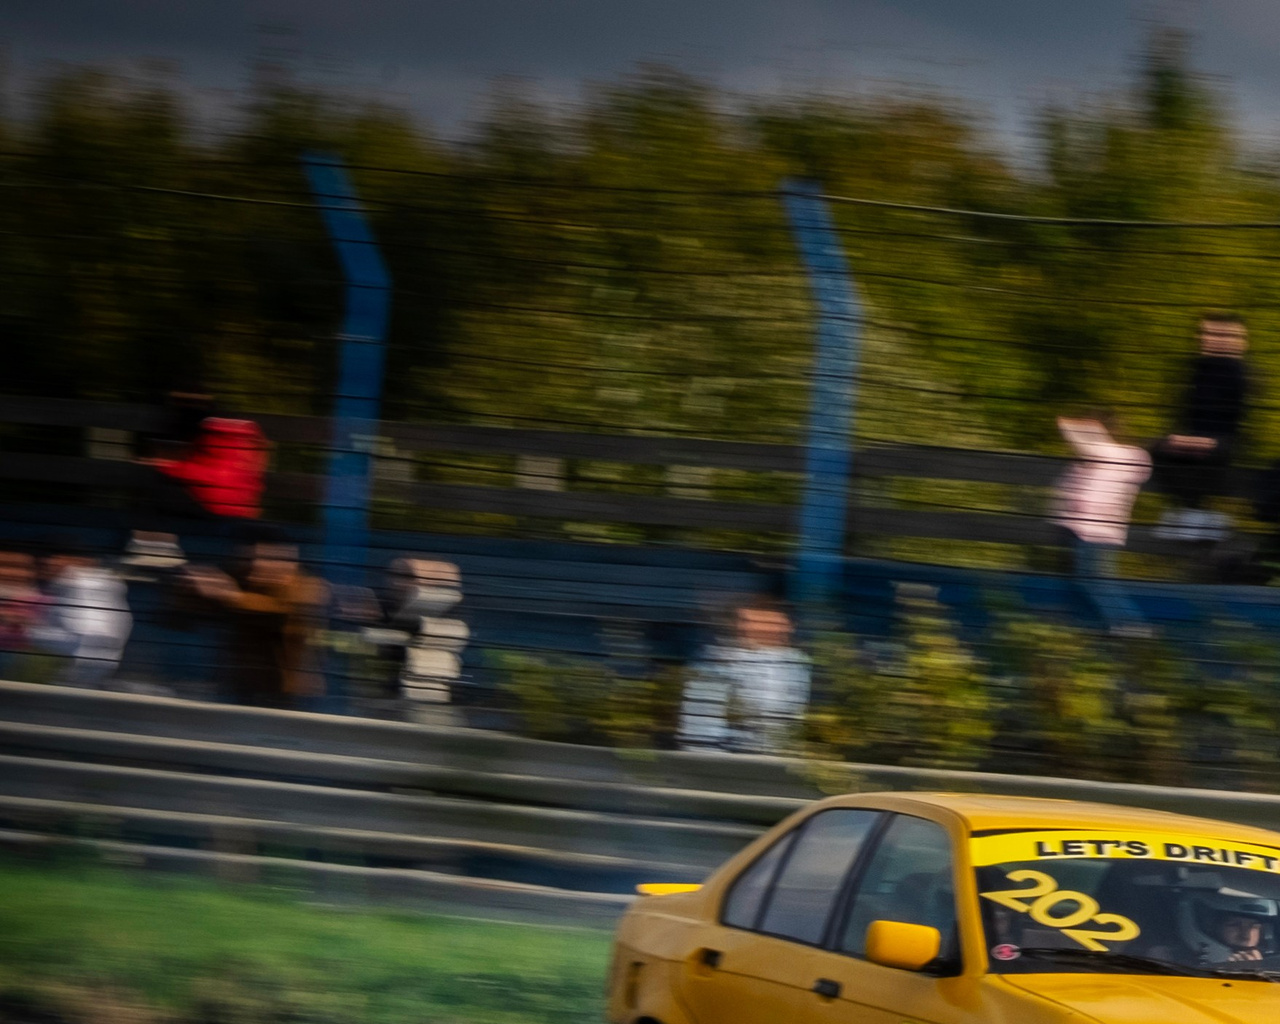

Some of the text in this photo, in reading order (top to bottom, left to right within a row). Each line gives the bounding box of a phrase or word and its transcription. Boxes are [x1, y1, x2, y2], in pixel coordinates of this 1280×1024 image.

[1035, 839, 1150, 857] LET'S
[1163, 842, 1280, 870] DRIFT
[979, 869, 1141, 952] 202
